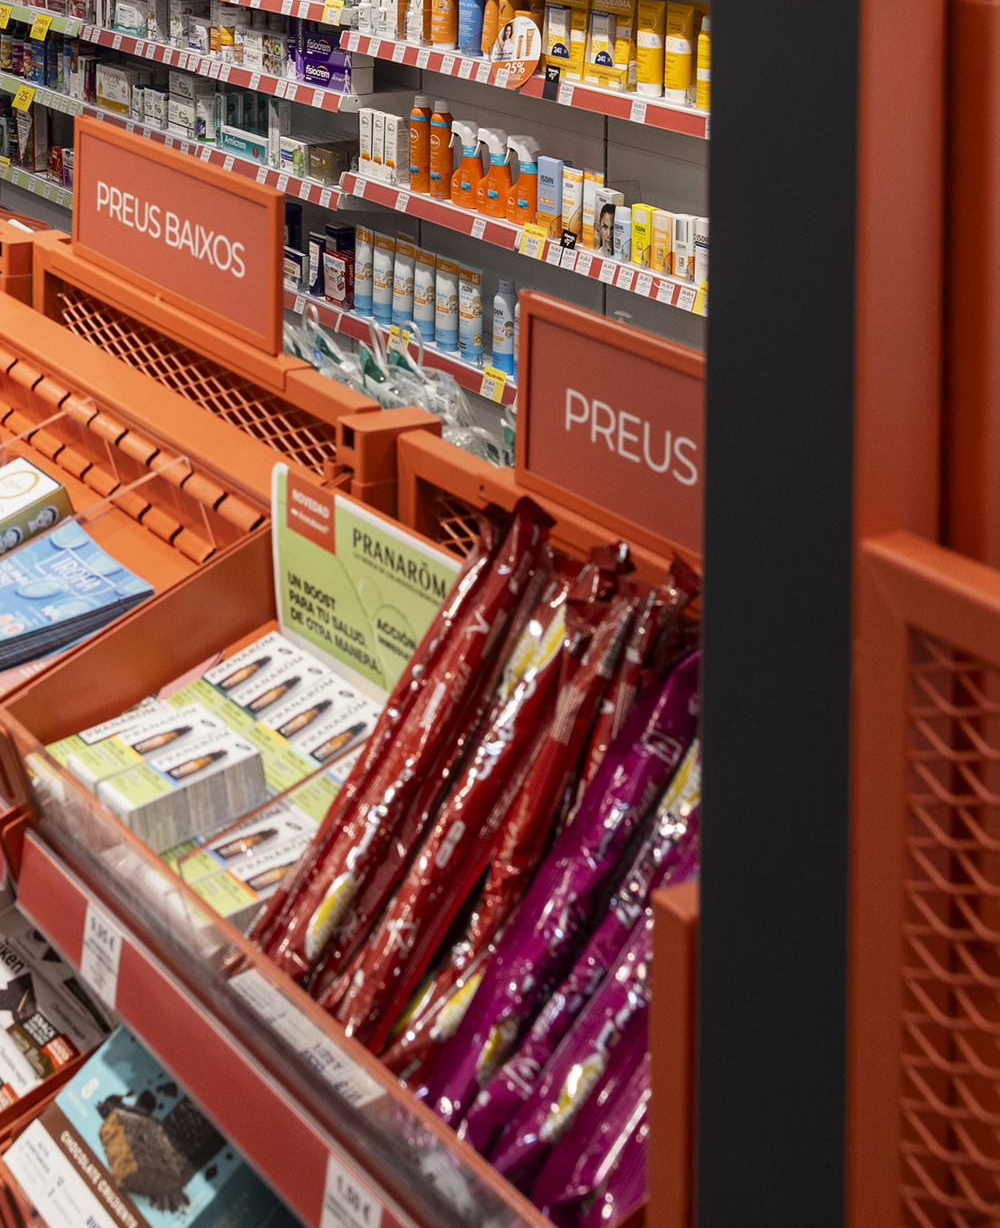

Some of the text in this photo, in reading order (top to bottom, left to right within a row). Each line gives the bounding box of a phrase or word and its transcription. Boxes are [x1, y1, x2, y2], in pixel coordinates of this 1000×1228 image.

[306, 41, 331, 53] fisiocrem
[305, 66, 330, 80] fisiocrem
[96, 180, 246, 279] PREUS BAIXOS
[565, 387, 698, 487] PREUS
[50, 557, 101, 592] IROHA
[289, 590, 314, 614] PARA
[303, 579, 336, 611] BOOST
[290, 607, 304, 626] DE
[306, 617, 331, 645] OTRA
